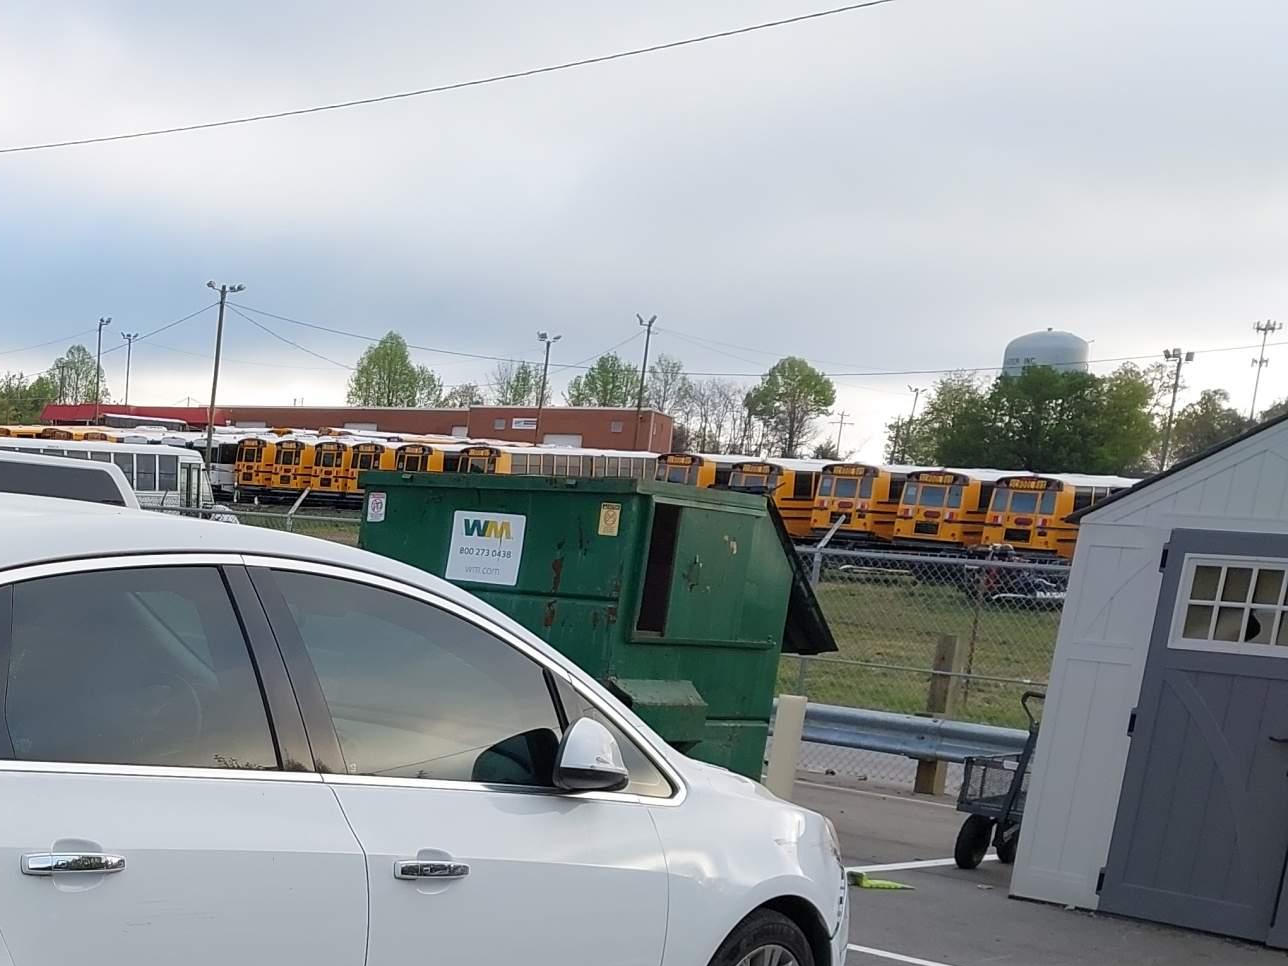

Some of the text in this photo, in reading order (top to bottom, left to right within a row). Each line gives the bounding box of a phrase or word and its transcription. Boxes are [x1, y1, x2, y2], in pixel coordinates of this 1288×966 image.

[464, 519, 512, 538] WM
[459, 546, 512, 559] 800 273 0438
[465, 566, 500, 576] wm.com
